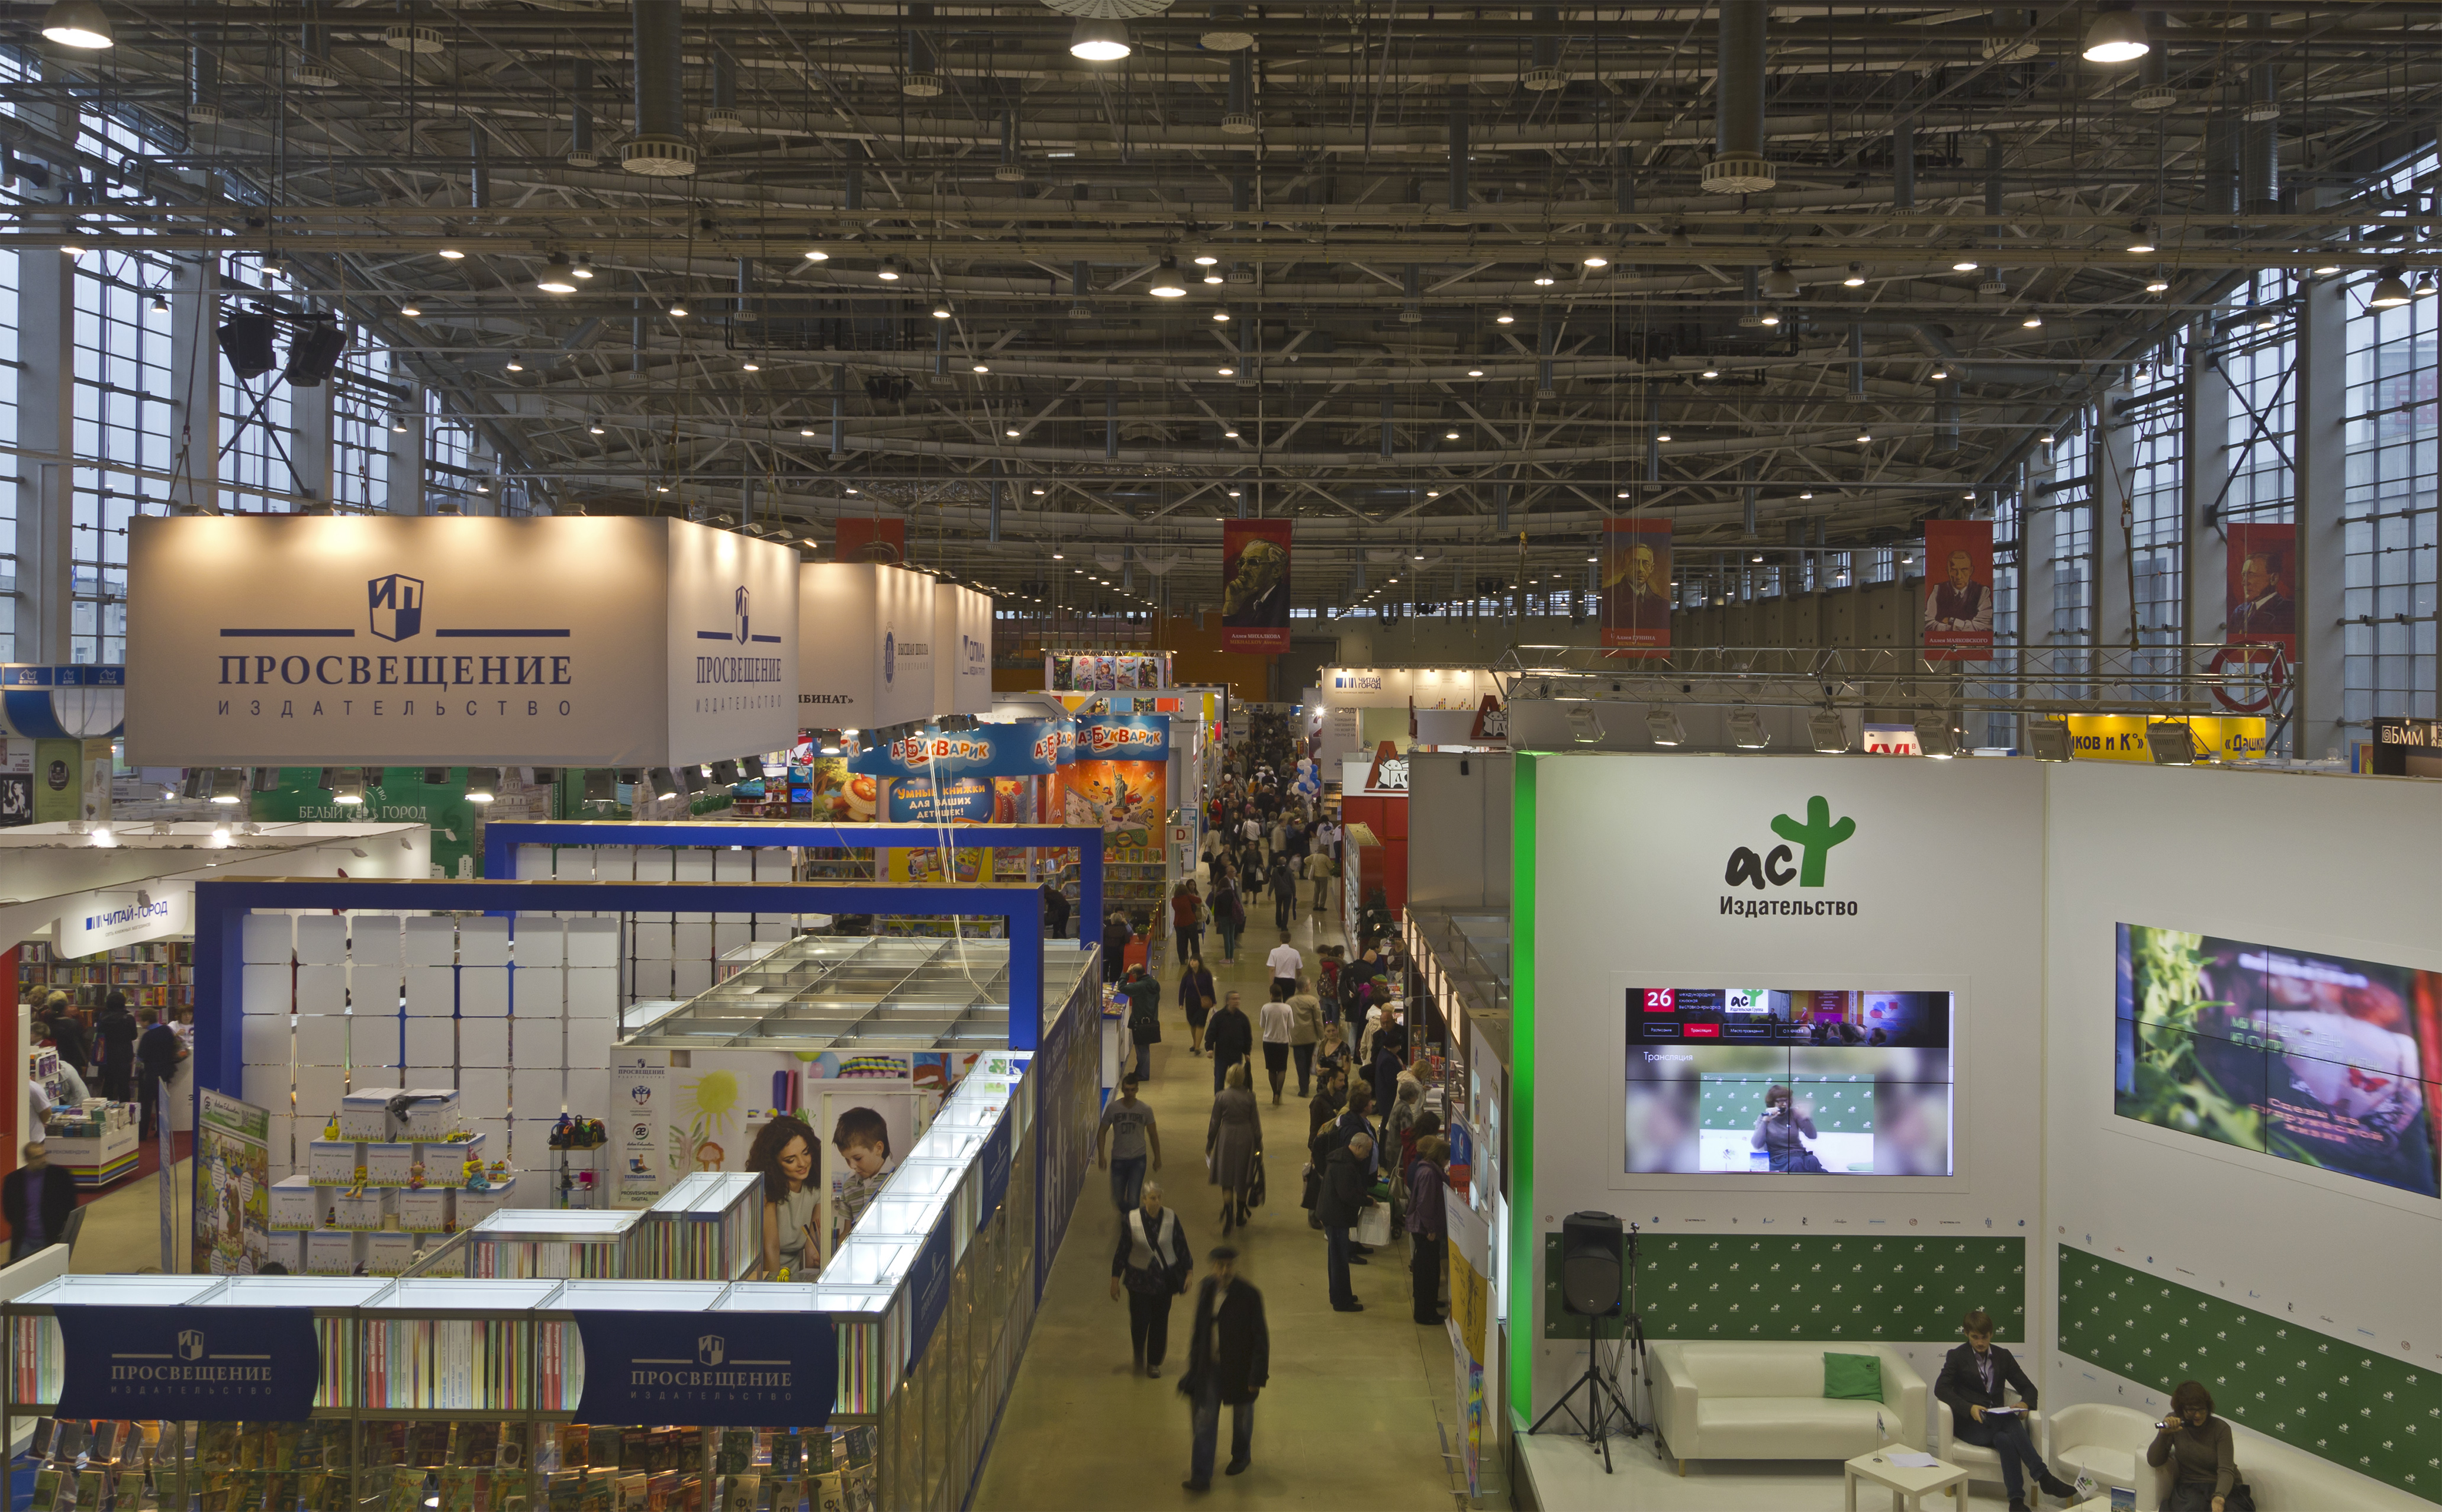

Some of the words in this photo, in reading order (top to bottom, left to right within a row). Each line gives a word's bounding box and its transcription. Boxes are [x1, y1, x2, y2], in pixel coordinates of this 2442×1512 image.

[969, 640, 985, 663] ОЛМА
[218, 655, 572, 692] ПРОСВЕЩЕНИЕ
[697, 656, 781, 689] ПРОСВЕЩЕНИЕ
[218, 700, 571, 718] ИЗДАТЕЛЬСТВО
[696, 695, 781, 714] ИЗДАТЕЛЬСТВО
[1078, 727, 1161, 744] АЗБУКВАРИК
[2106, 736, 2115, 750] и
[2392, 726, 2424, 746] БММ
[299, 804, 343, 819] БЕЛЫЙ
[909, 800, 930, 810] ДЛЯ
[936, 797, 971, 807] ВАШИХ
[383, 805, 427, 821] ГОРОД
[917, 810, 964, 819] ДЕТИШЕК!
[1720, 896, 1857, 918] Издательство
[1648, 988, 1671, 1007] 26
[1644, 1051, 1693, 1063] Трансляция
[111, 1365, 272, 1384] ПРОСВЕЩЕНИЕ
[631, 1371, 792, 1388] ПРОСВЕЩЕНИЕ
[111, 1386, 272, 1395] ИЗДАТЕЛЬСТВО
[631, 1391, 791, 1401] ИЗДАТЕЛЬСТВО
